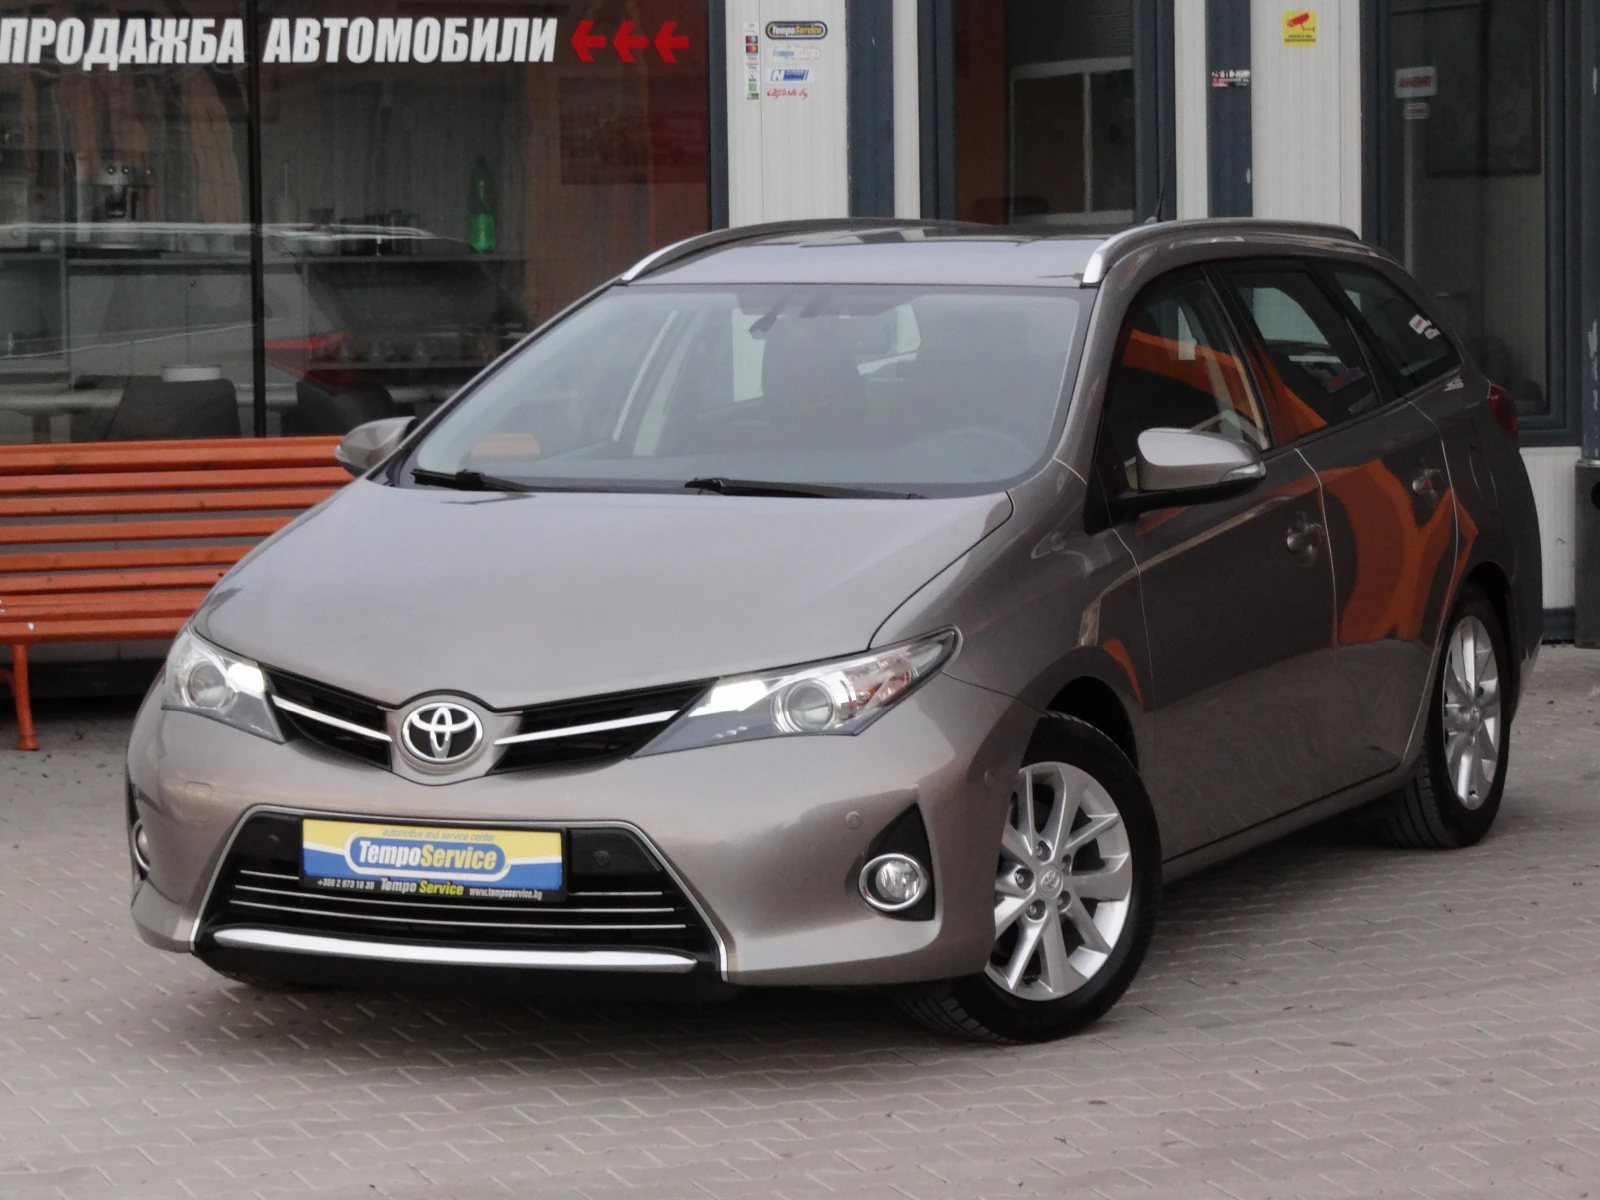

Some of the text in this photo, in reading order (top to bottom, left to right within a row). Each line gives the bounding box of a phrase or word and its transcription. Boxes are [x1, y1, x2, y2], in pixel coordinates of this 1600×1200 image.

[0, 17, 558, 72] ПРОДАЖБА АВТОМОБИЛИ
[382, 828, 495, 842] automotive and service center
[359, 840, 498, 870] TempoService
[381, 877, 418, 894] Tempo
[419, 880, 464, 895] Service
[469, 887, 543, 900] www.temposervice.bg
